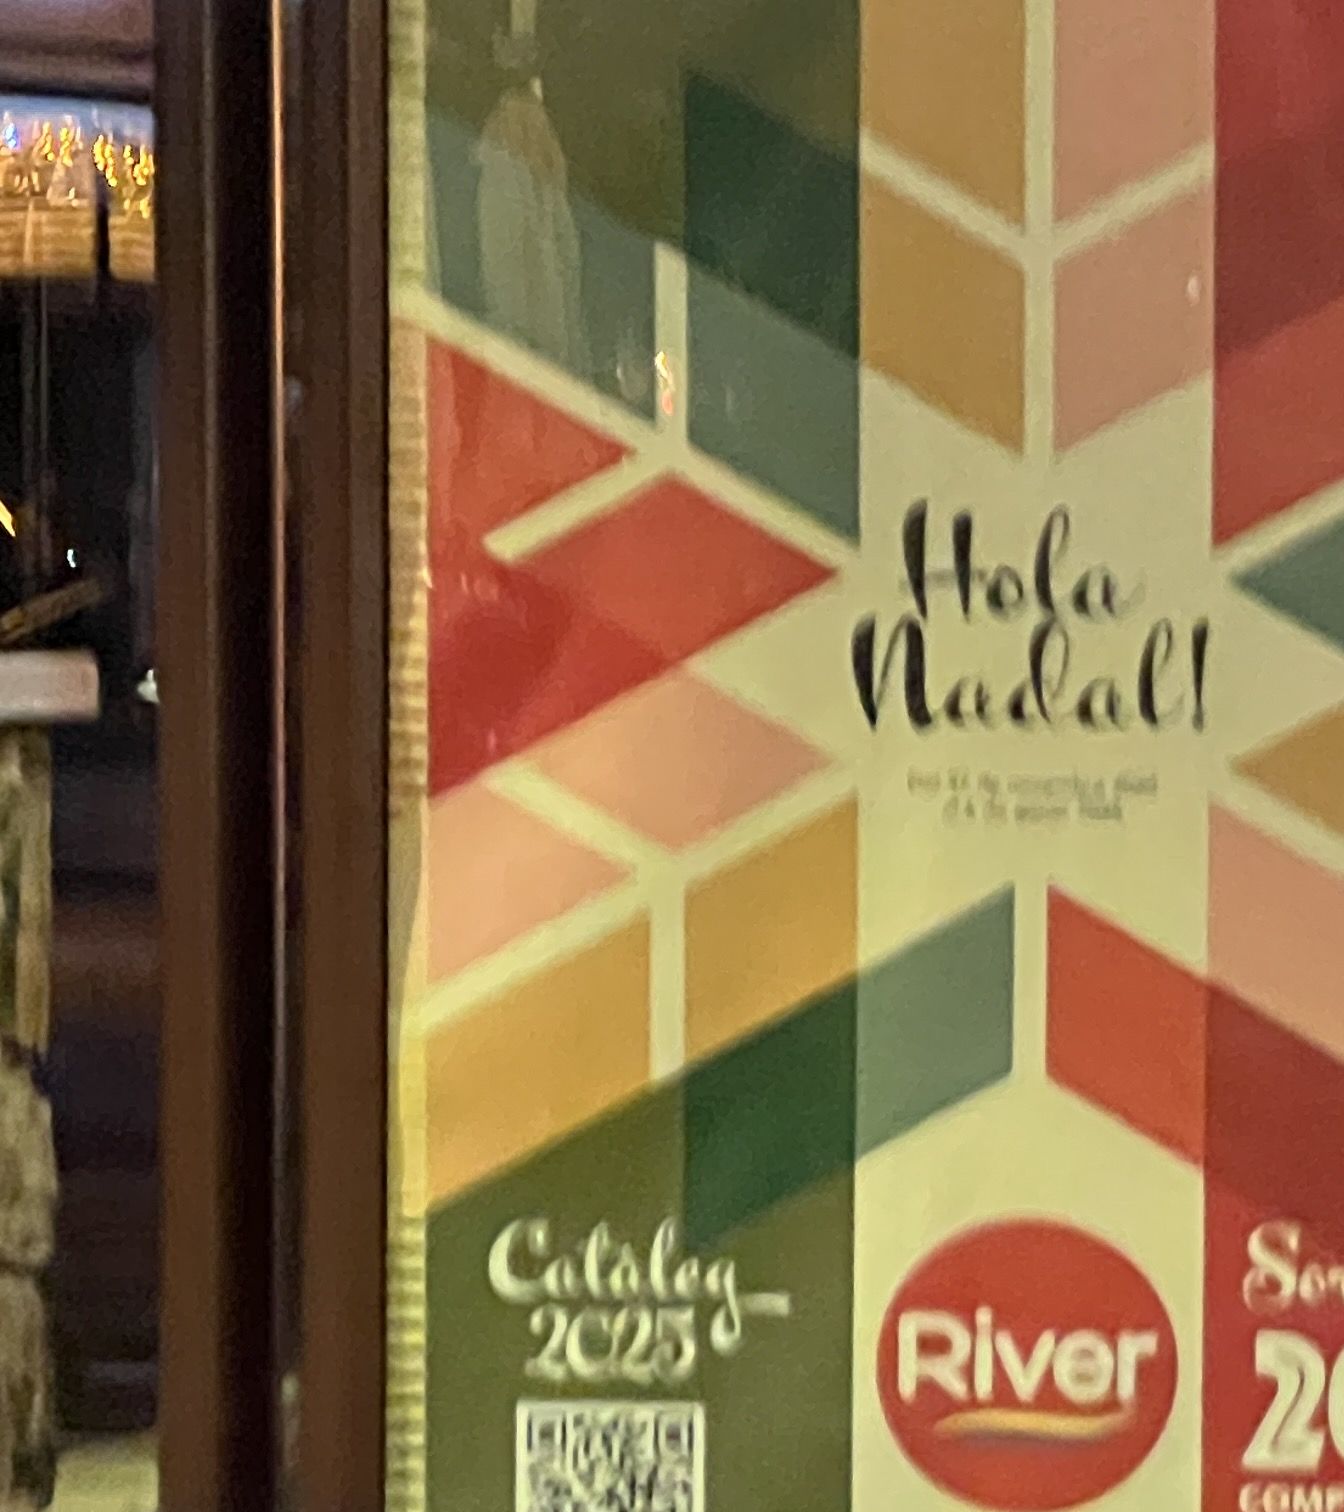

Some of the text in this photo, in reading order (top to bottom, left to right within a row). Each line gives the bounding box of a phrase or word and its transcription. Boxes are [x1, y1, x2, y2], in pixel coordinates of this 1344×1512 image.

[902, 499, 1145, 622] Hola
[851, 612, 1209, 732] Nadal!
[523, 1303, 698, 1384] 2025
[898, 1305, 1159, 1406] River
